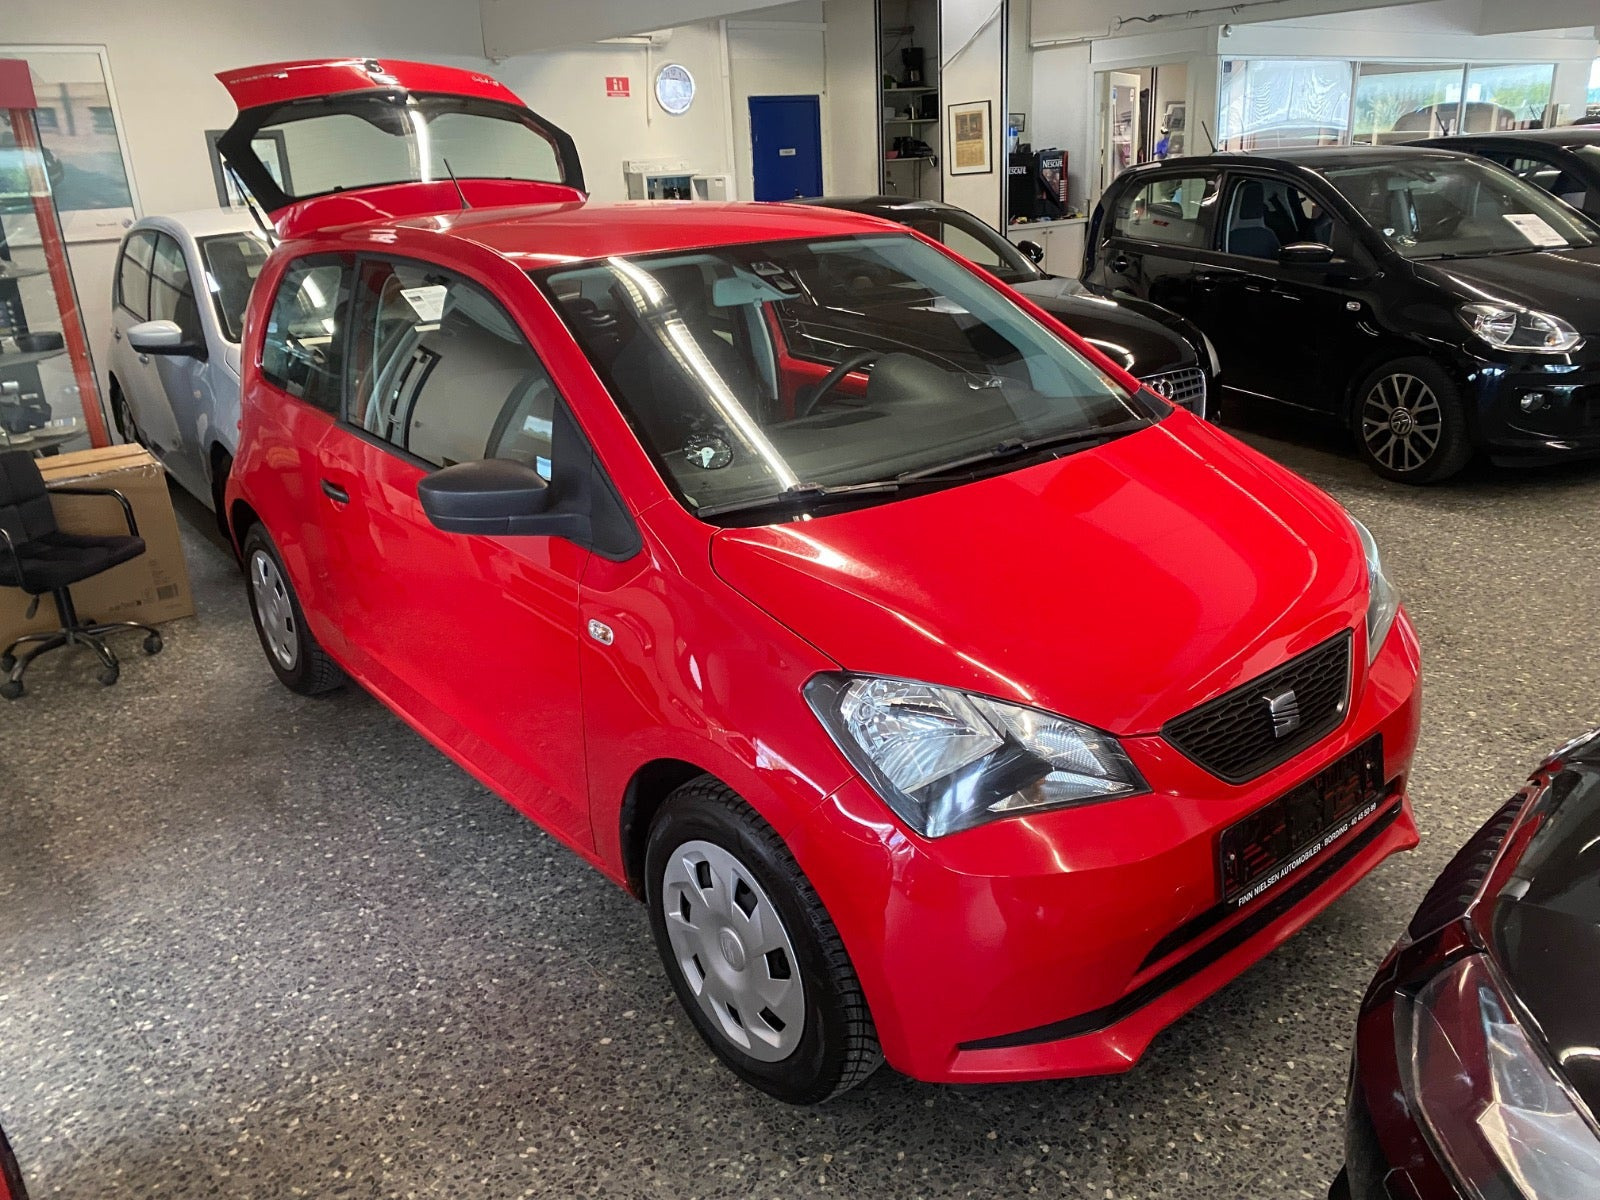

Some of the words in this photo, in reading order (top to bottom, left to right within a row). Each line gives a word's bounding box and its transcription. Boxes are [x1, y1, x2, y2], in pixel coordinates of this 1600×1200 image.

[1238, 890, 1253, 907] FINN
[1254, 871, 1280, 896] NIELSEN
[1280, 843, 1321, 878] AUTOMOBILER
[1324, 823, 1348, 846] BORDING
[1351, 816, 1357, 826] 40
